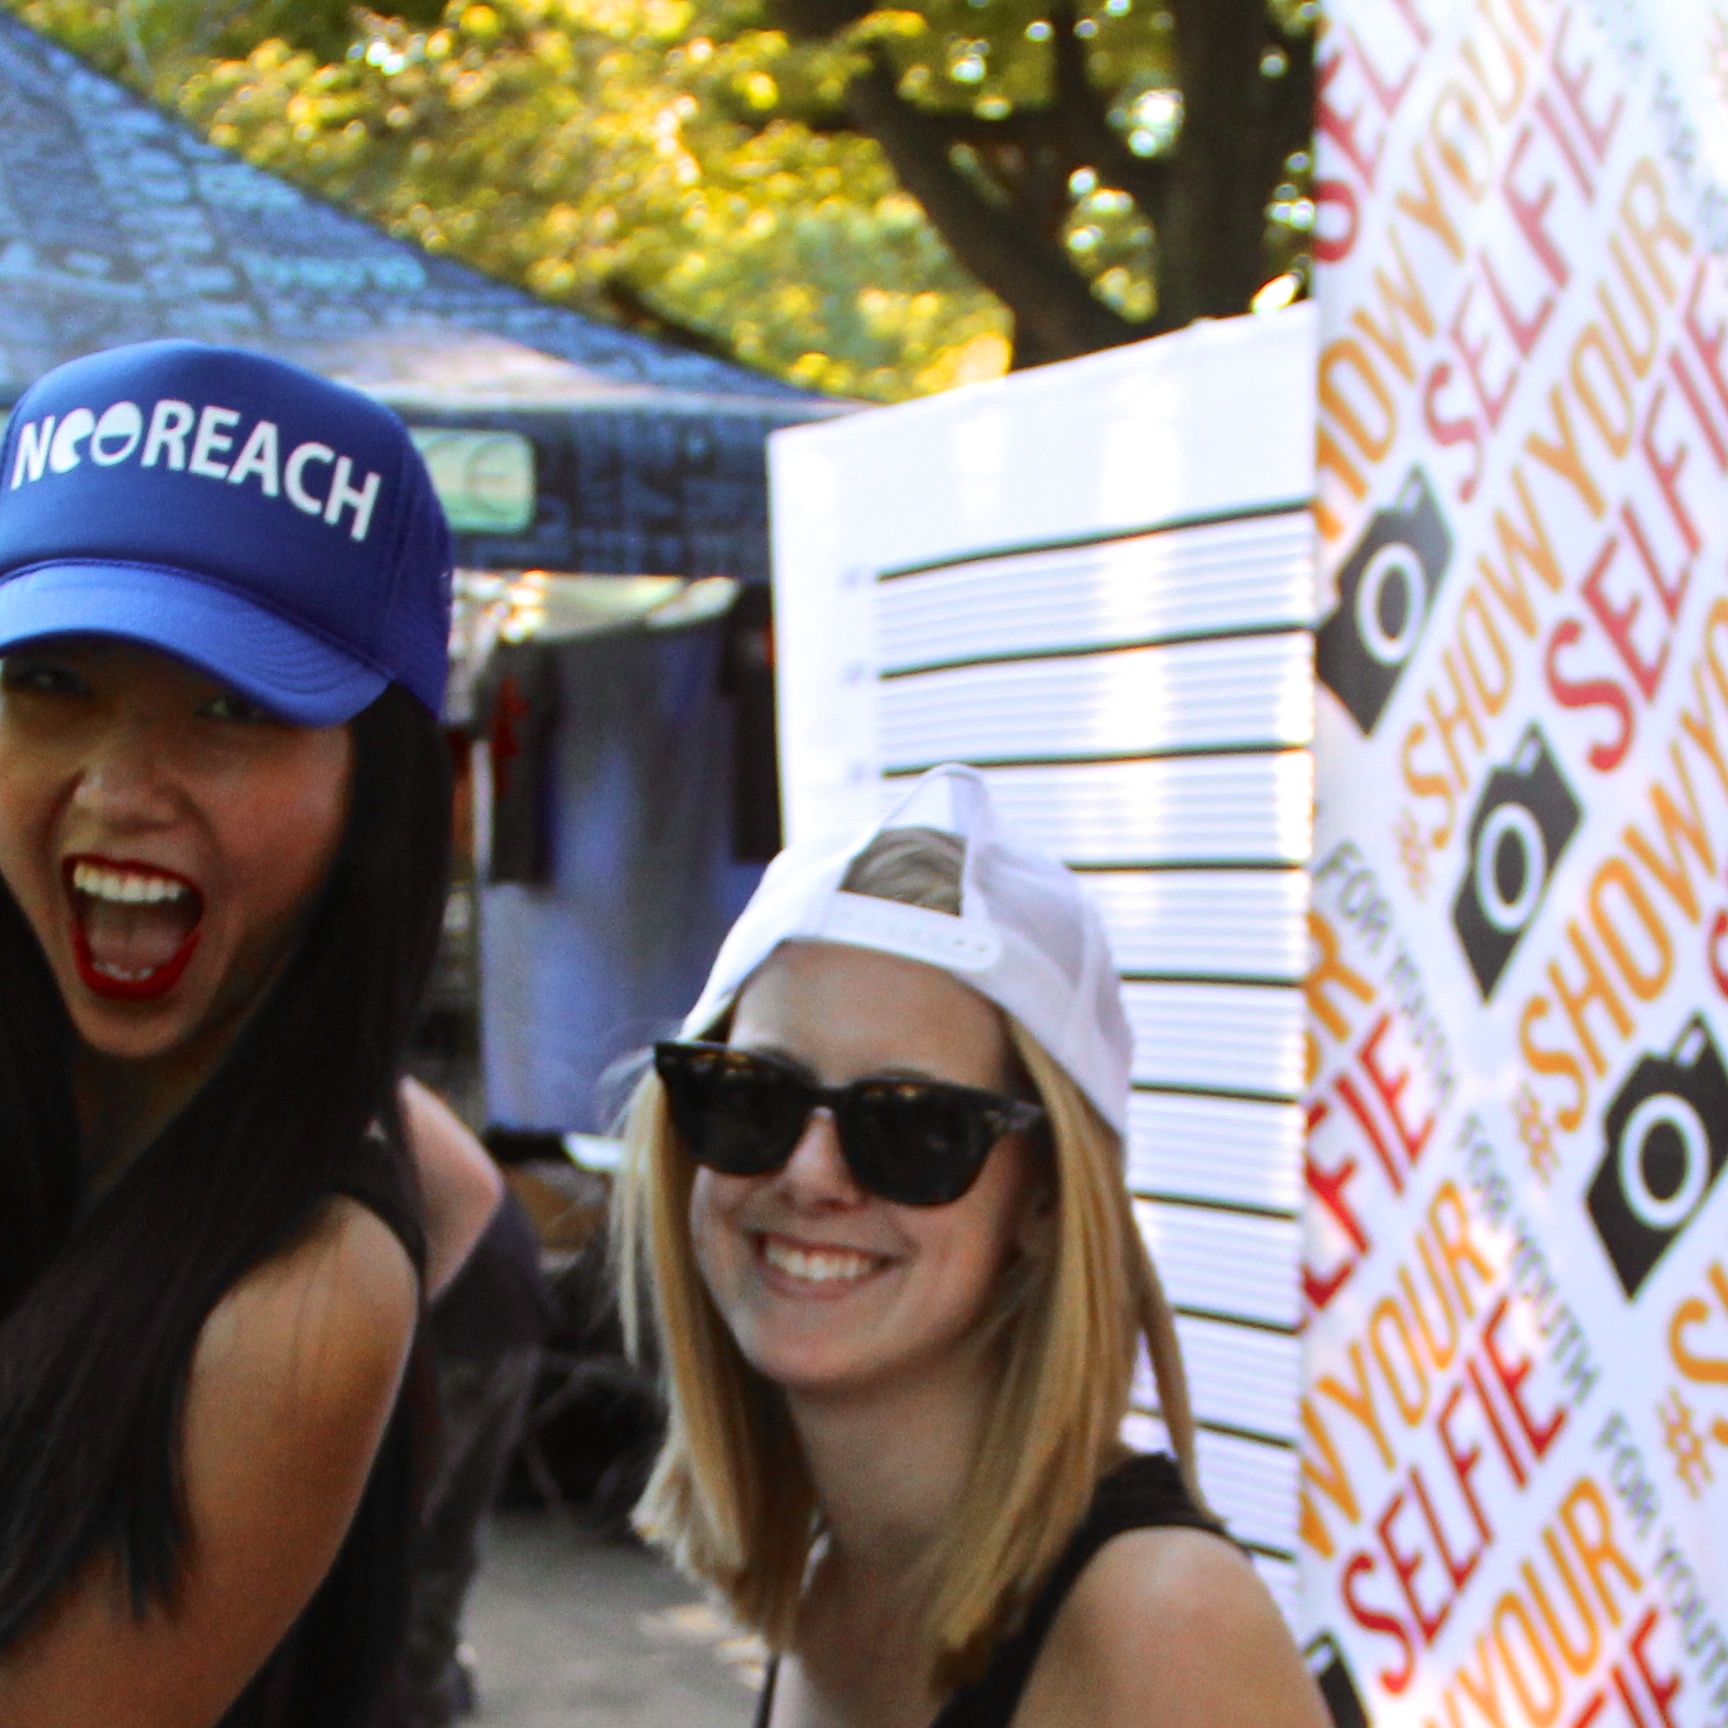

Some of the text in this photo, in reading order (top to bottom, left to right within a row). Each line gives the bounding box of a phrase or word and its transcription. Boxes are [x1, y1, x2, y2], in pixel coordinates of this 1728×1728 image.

[1422, 5, 1626, 502] SELFIE
[1396, 156, 1696, 900] #SHOWYOUR
[1341, 1295, 1568, 1696] SELFIE
